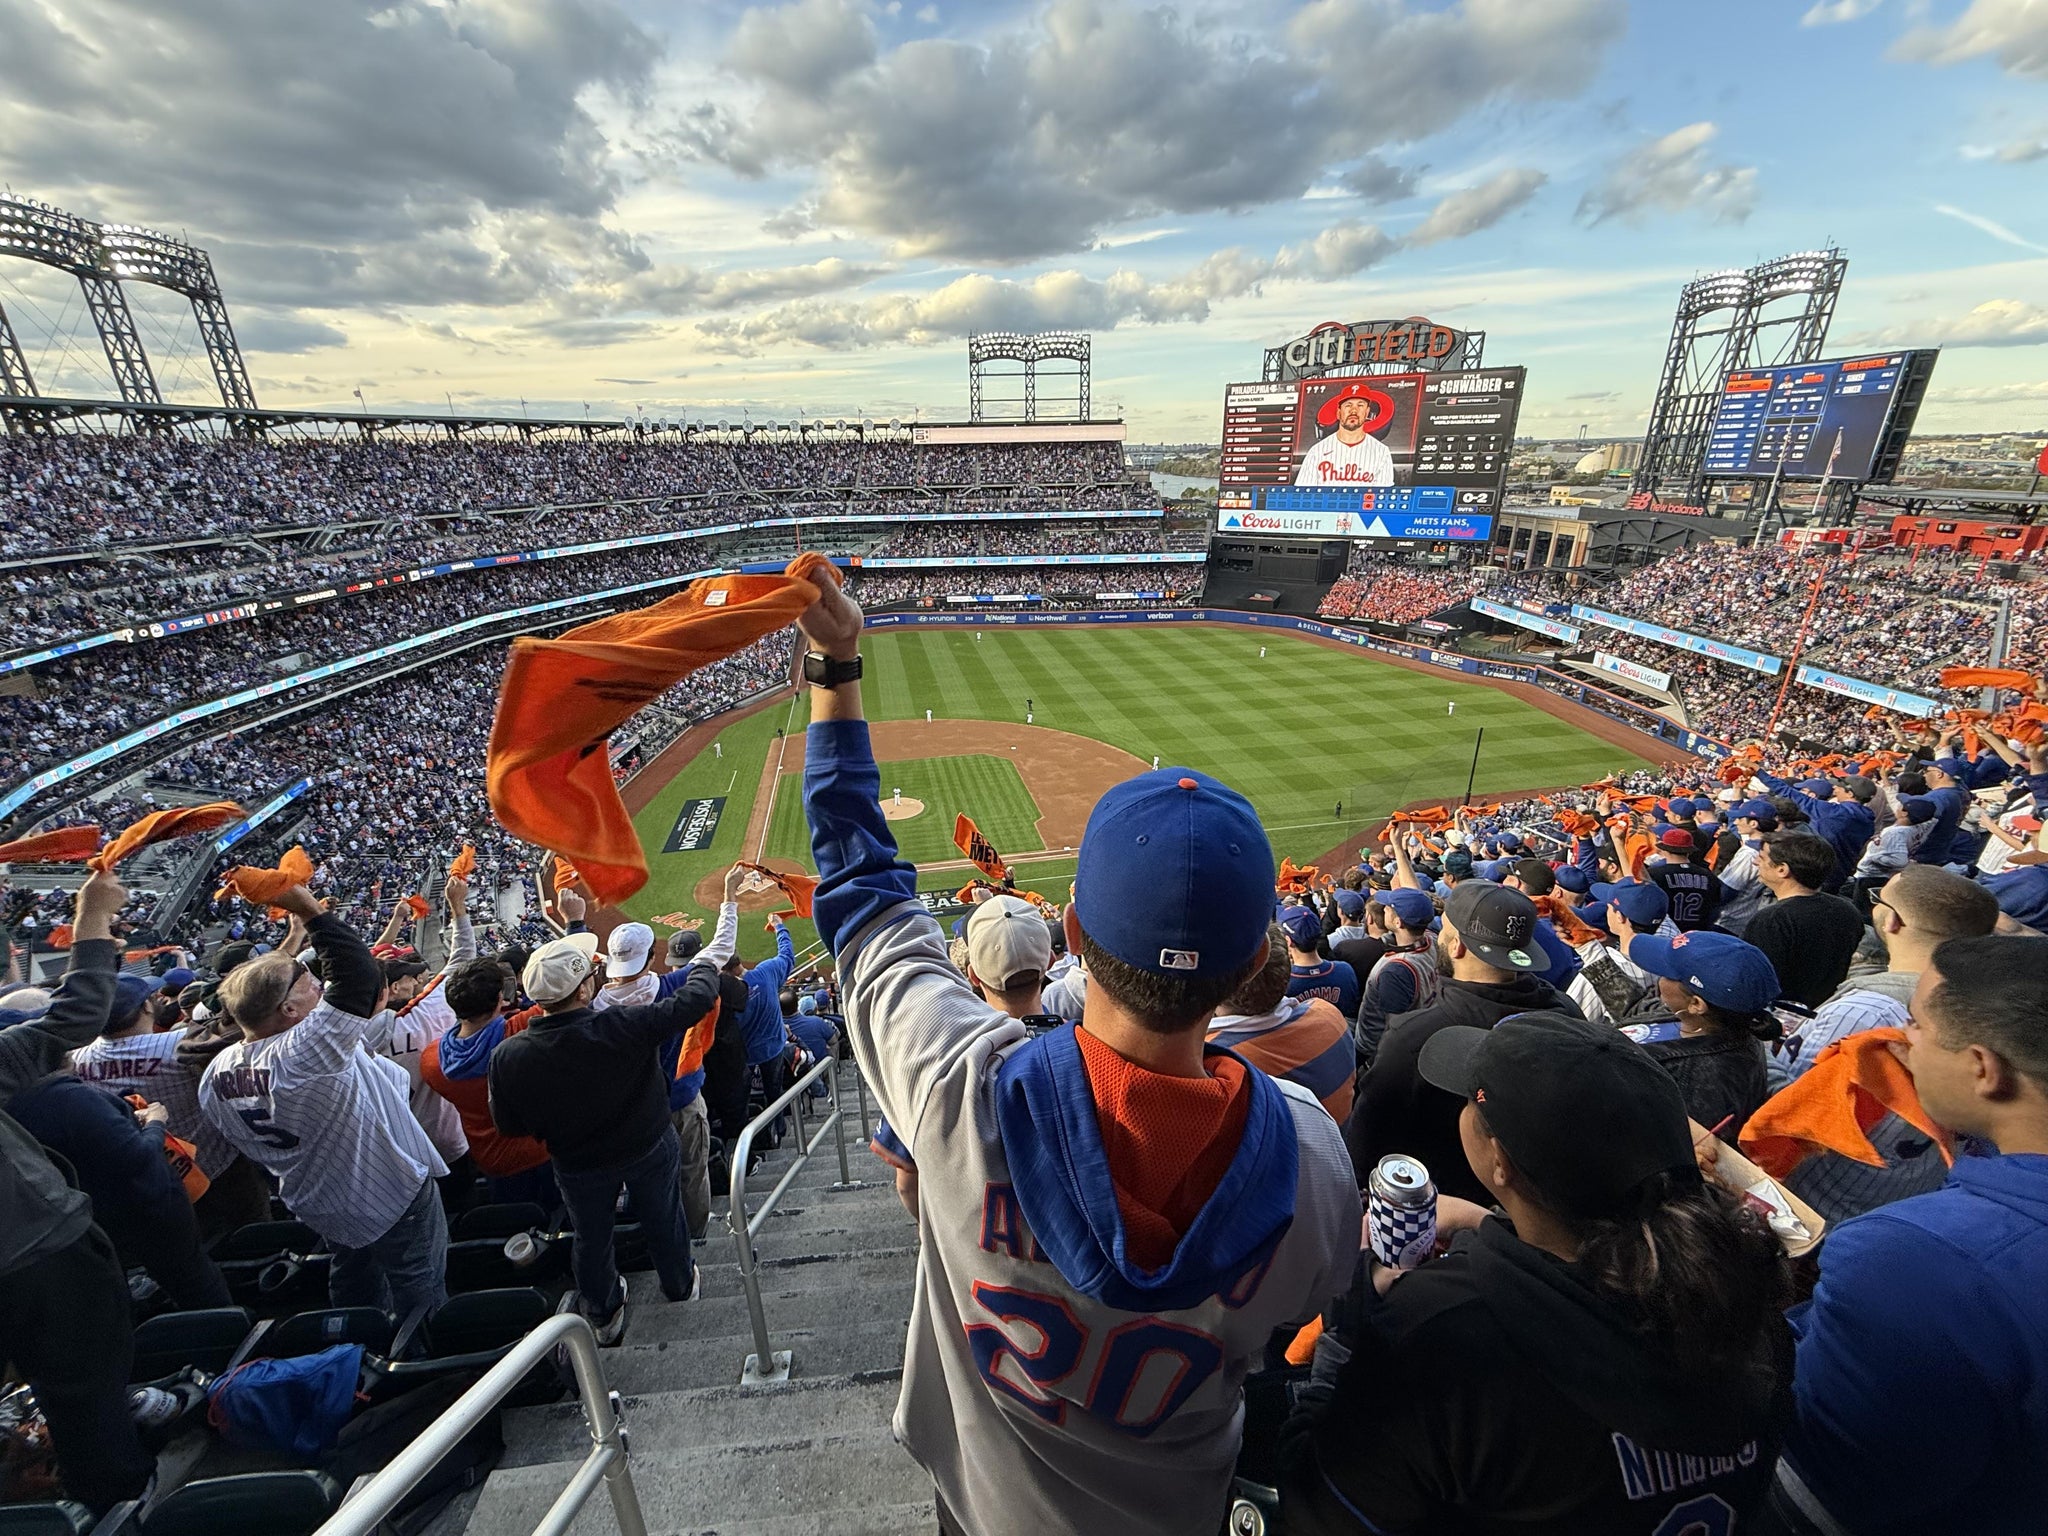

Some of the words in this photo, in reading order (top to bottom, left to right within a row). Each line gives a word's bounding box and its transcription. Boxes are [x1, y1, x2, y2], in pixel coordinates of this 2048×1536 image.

[1286, 330, 1345, 366] citi
[1354, 326, 1454, 362] FIELD
[1231, 385, 1269, 394] PHILADELPHIA
[1440, 378, 1502, 394] SCHWARBER
[1318, 460, 1376, 483] Phillies
[1463, 493, 1488, 503] 0-2
[1650, 502, 1667, 511] new
[1668, 503, 1704, 515] balance
[1242, 513, 1281, 528] Coors
[1284, 519, 1321, 529] LIGHT
[1441, 518, 1469, 527] FANS,
[1448, 528, 1477, 537] Chill
[294, 590, 337, 604] SCHWARBER
[1303, 624, 1321, 632] DELTA
[1545, 624, 1561, 634] Chill
[1660, 632, 1680, 642] Chill
[1439, 653, 1463, 664] CAESARS
[1707, 644, 1726, 656] Coors
[1727, 651, 1747, 662] LIGHT
[1619, 663, 1640, 678] Coors
[1640, 671, 1662, 686] LIGHT
[1824, 676, 1849, 690] Coors
[1849, 686, 1875, 698] LIGHT
[72, 758, 91, 770] Coors
[679, 799, 714, 850] POSTSEASON
[1665, 874, 1708, 890] LINDOR
[1673, 892, 1703, 921] 12
[651, 912, 705, 930] Mets
[77, 1058, 162, 1081] ALVAREZ
[212, 1068, 271, 1099] WRIGHT
[236, 1108, 300, 1148] 5
[964, 1280, 1224, 1437] 20
